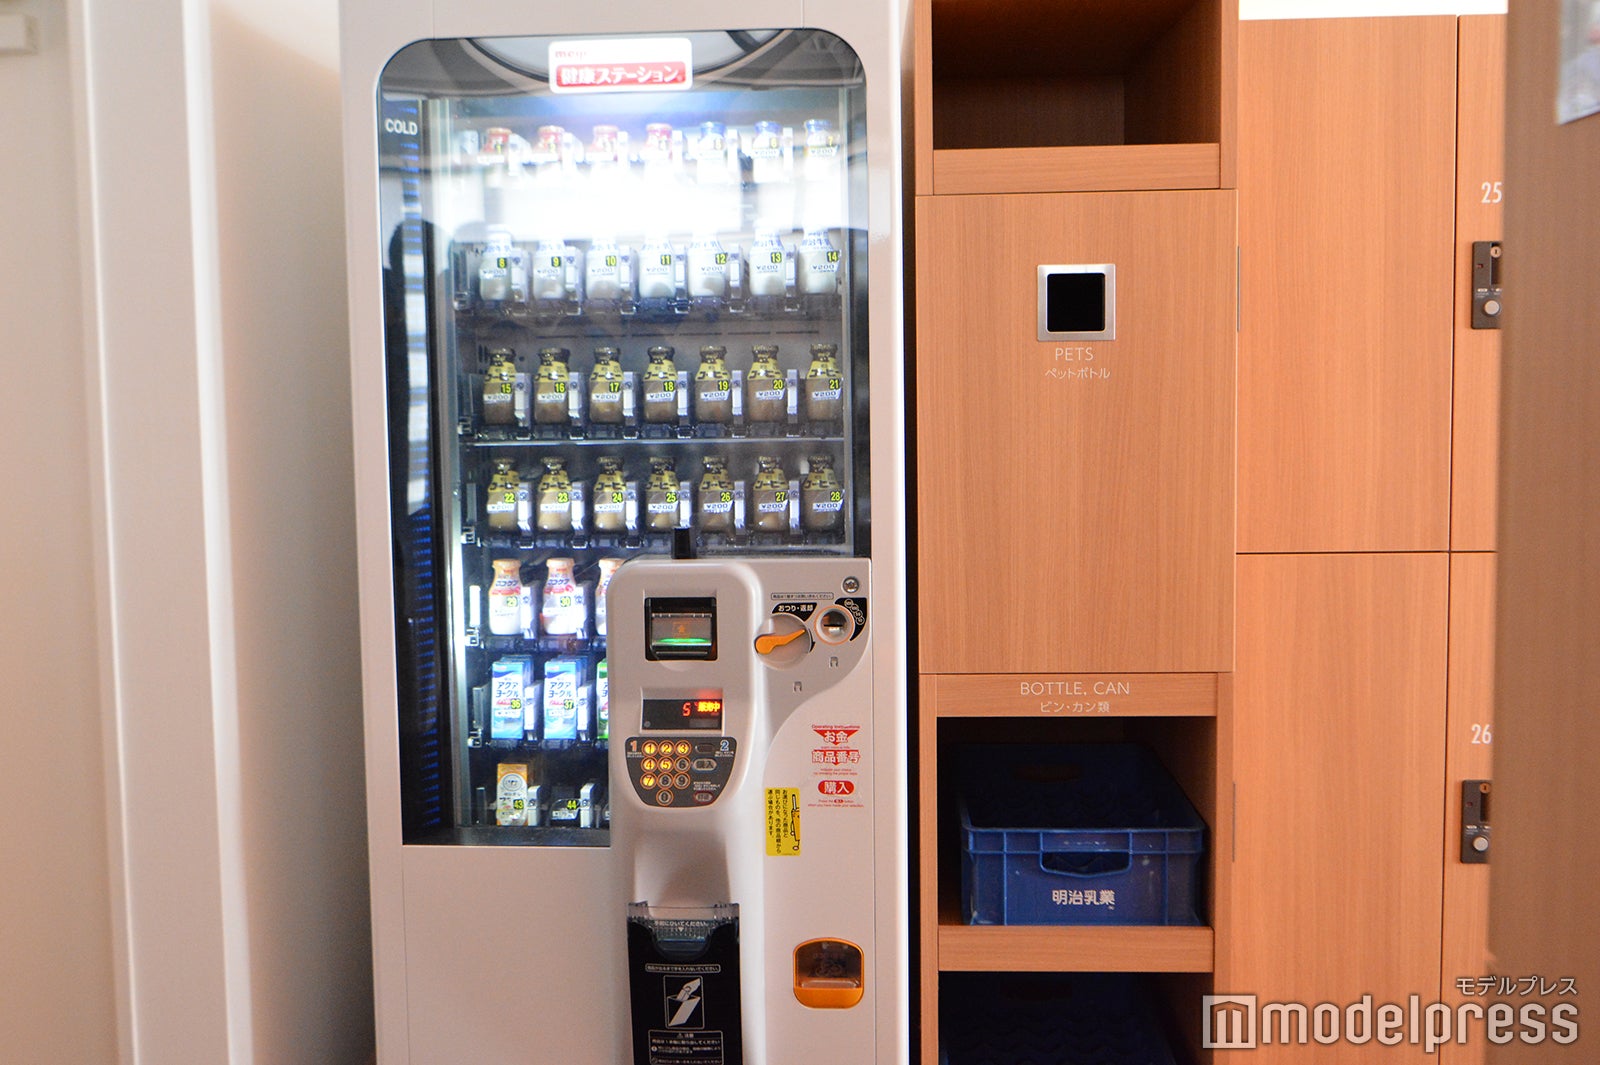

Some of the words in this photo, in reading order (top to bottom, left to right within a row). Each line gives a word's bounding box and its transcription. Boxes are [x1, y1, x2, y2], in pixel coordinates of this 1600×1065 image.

[560, 66, 679, 85] 健康ステーション
[385, 118, 418, 136] COLD
[1481, 181, 1502, 204] 25
[553, 256, 561, 267] 9
[607, 256, 617, 266] 10
[661, 255, 671, 265] 11
[716, 254, 727, 264] 12
[771, 253, 782, 263] 13
[828, 252, 838, 262] 14
[499, 258, 507, 268] 8
[1055, 347, 1094, 361] PETS
[1045, 367, 1111, 380] ペットボトル
[501, 383, 511, 393] 15
[555, 382, 565, 392] 16
[609, 382, 619, 392] 17
[663, 382, 674, 391] 18
[718, 381, 728, 391] 19
[773, 380, 783, 389] 20
[829, 380, 839, 389] 21
[504, 493, 515, 503] 22
[558, 493, 568, 502] 23
[612, 493, 623, 503] 24
[666, 492, 676, 502] 25
[721, 492, 731, 501] 26
[775, 492, 785, 501] 27
[831, 491, 841, 501] 28
[497, 682, 519, 690] アクア
[549, 681, 571, 690] アクア
[1093, 681, 1130, 695] CAN
[495, 690, 519, 698] ヨークル
[548, 690, 572, 698] ヨークル
[564, 699, 574, 709] 37
[682, 702, 691, 716] 5
[823, 731, 848, 743] お金
[1471, 723, 1492, 745] 26
[812, 750, 860, 764] 商品番号
[824, 781, 850, 794] 購入
[513, 799, 524, 809] 43
[566, 799, 577, 809] 44
[1052, 889, 1115, 906] 明治乳業
